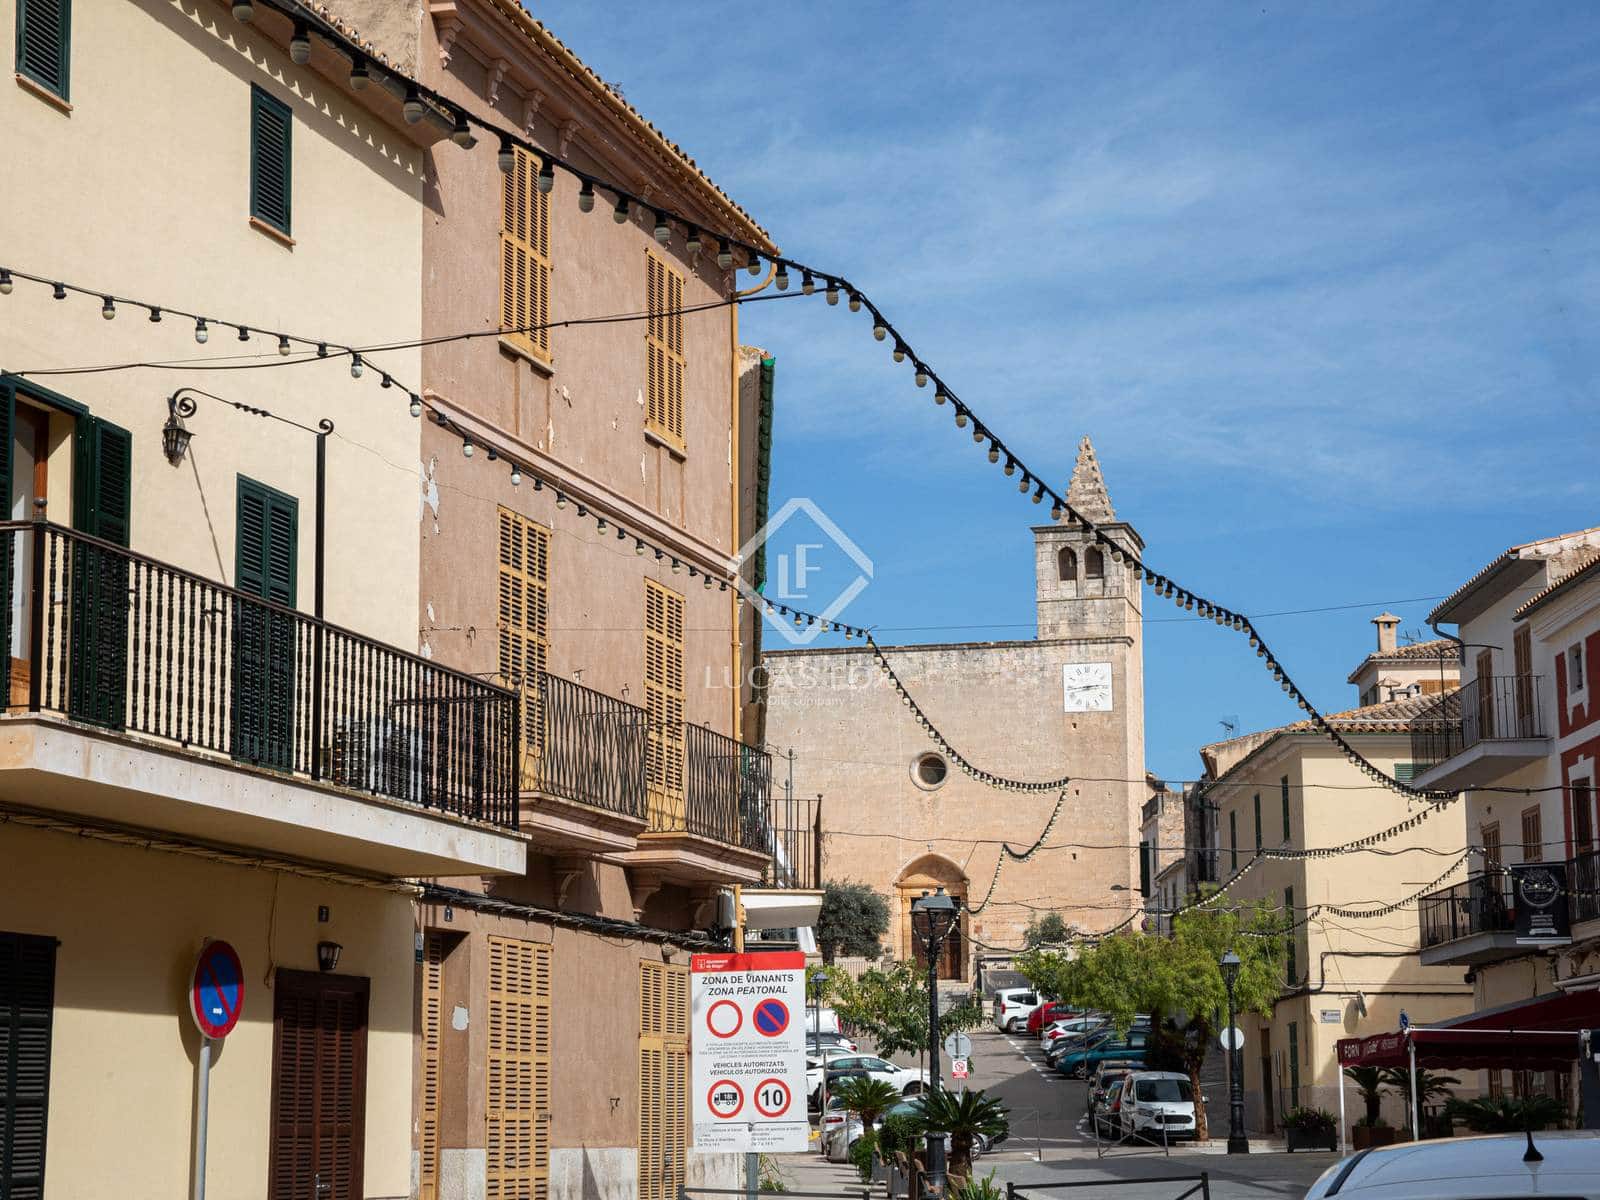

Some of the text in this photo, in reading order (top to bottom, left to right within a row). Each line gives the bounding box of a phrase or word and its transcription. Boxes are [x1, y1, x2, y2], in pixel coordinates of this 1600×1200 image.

[702, 974, 794, 985] ZONA DE VIANANTS
[708, 986, 788, 996] ZONA PEATONAL
[761, 1089, 783, 1106] 10
